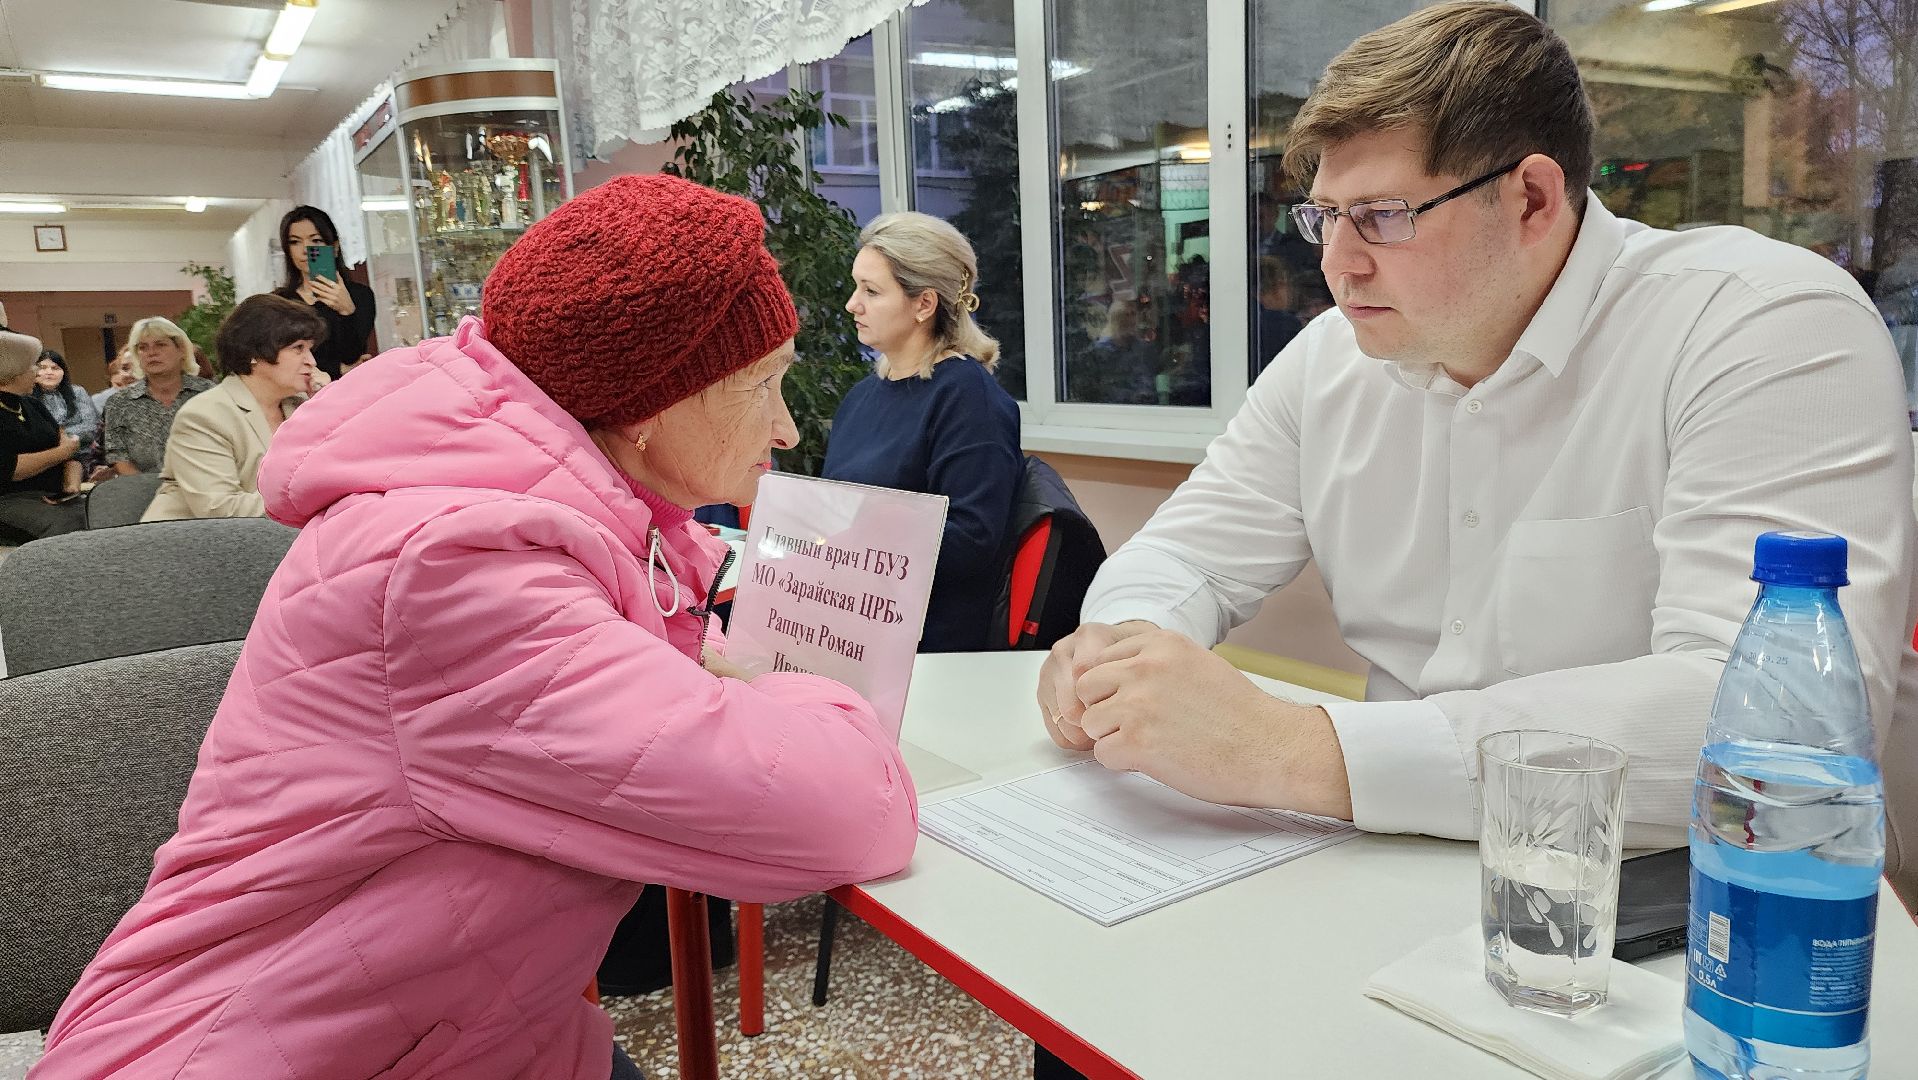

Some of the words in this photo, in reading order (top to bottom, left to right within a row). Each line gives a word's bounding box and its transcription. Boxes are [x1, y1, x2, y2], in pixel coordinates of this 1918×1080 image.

[825, 545, 860, 571] врач
[862, 547, 909, 581] ГБУЗ
[751, 562, 776, 587] МО
[778, 571, 855, 613] «Зарайская
[859, 592, 903, 626] ЦРБ»
[766, 607, 816, 646] Рапцун
[818, 623, 865, 662] Роман
